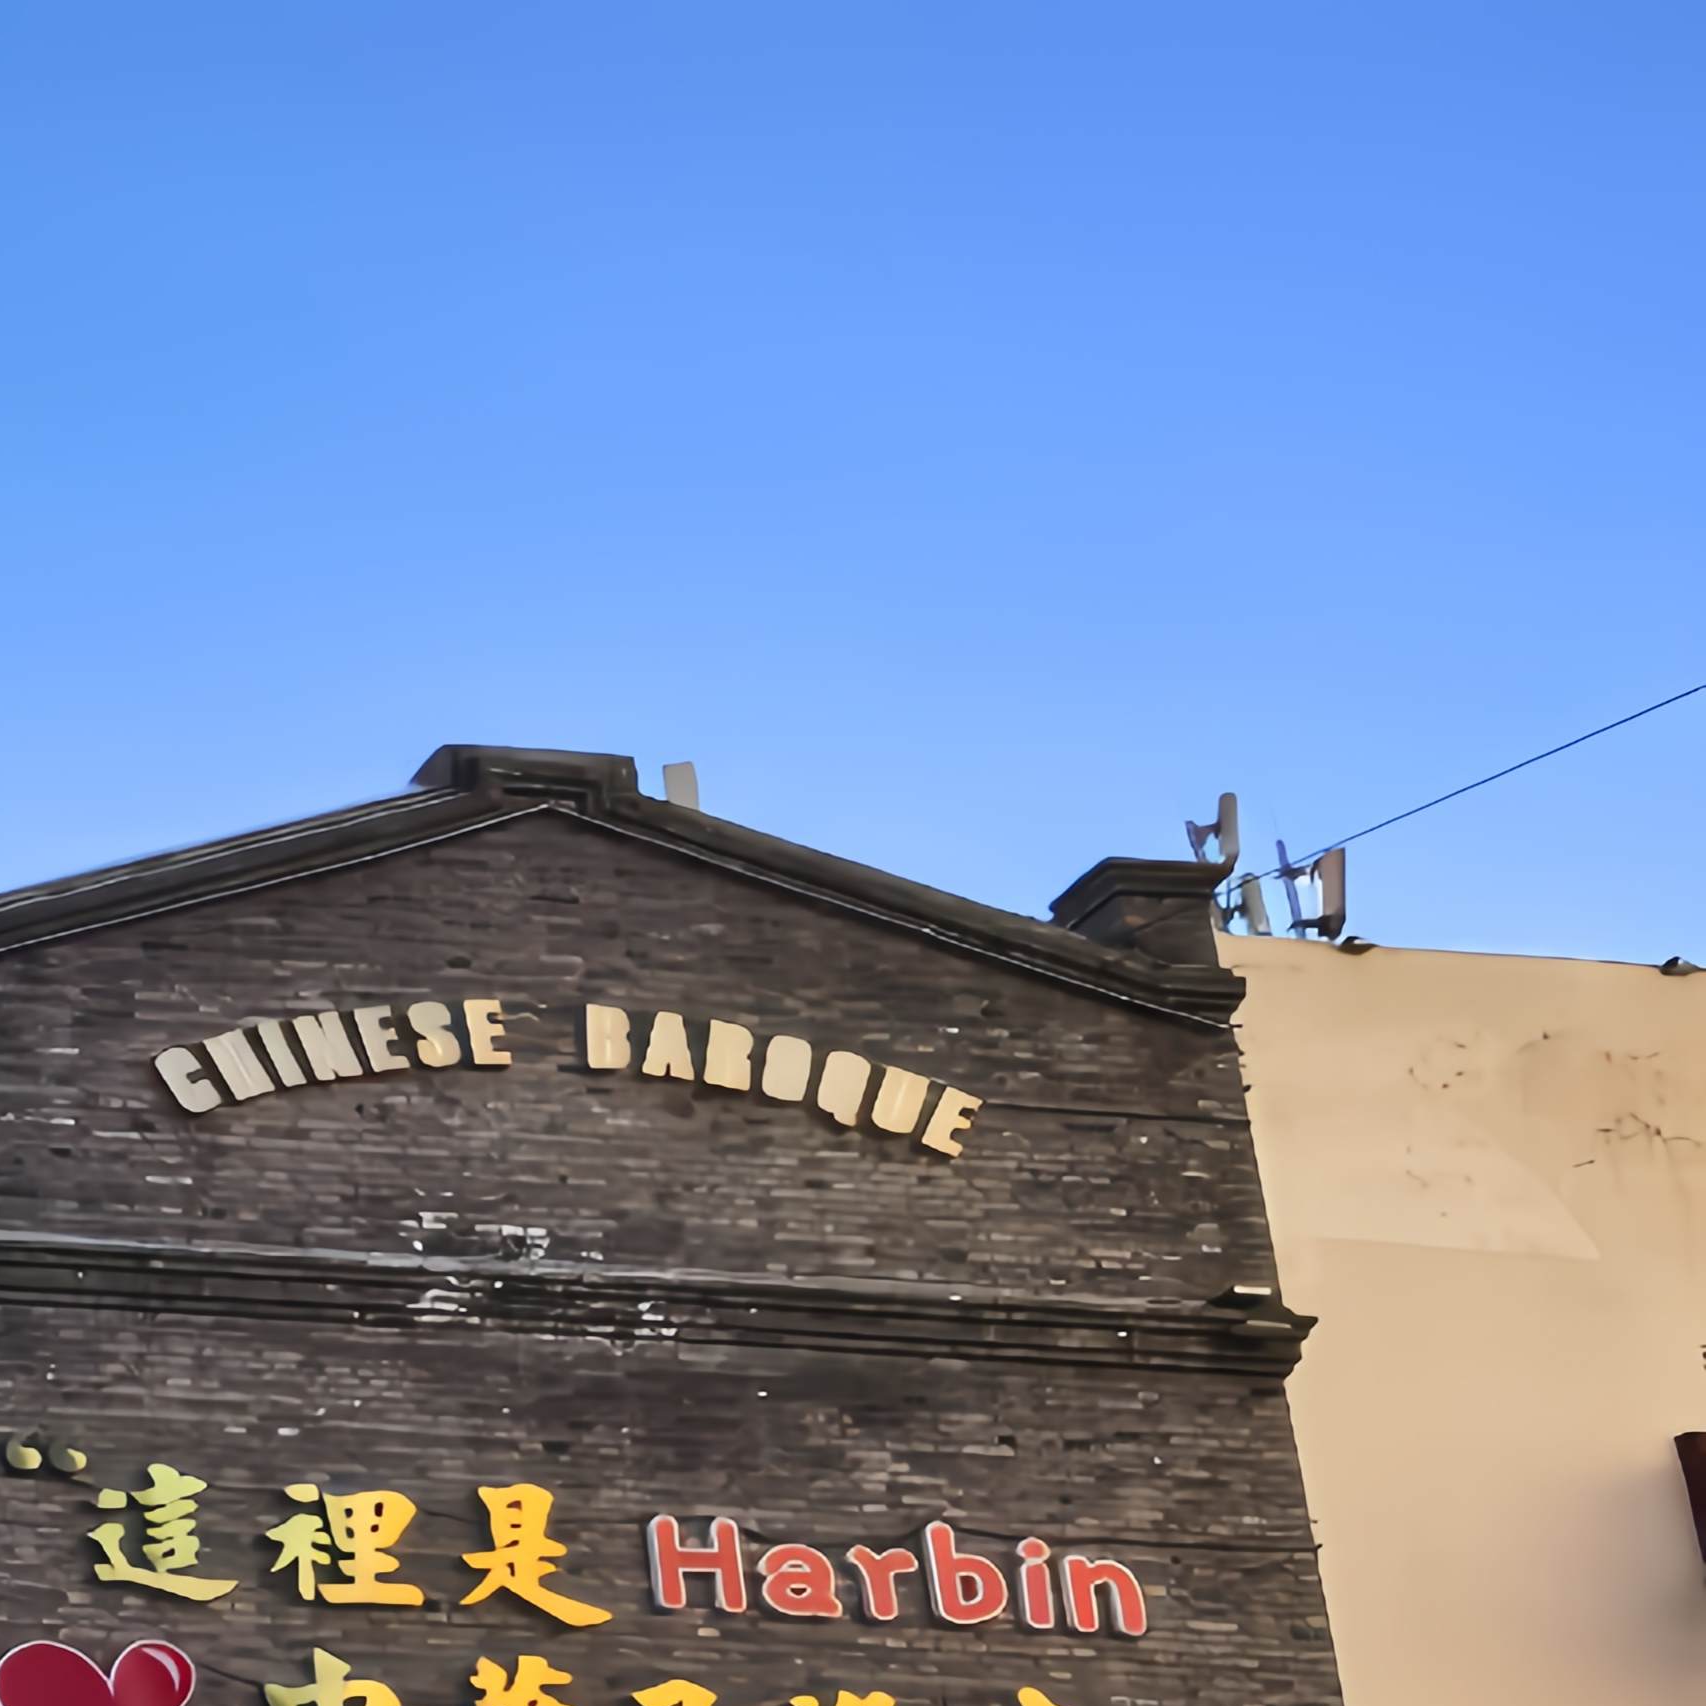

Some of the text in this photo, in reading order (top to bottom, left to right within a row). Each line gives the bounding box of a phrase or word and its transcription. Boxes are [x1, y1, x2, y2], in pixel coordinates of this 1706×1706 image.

[154, 1000, 984, 1158] CHINESE BAROQUE
[646, 1513, 1150, 1637] Harbin
